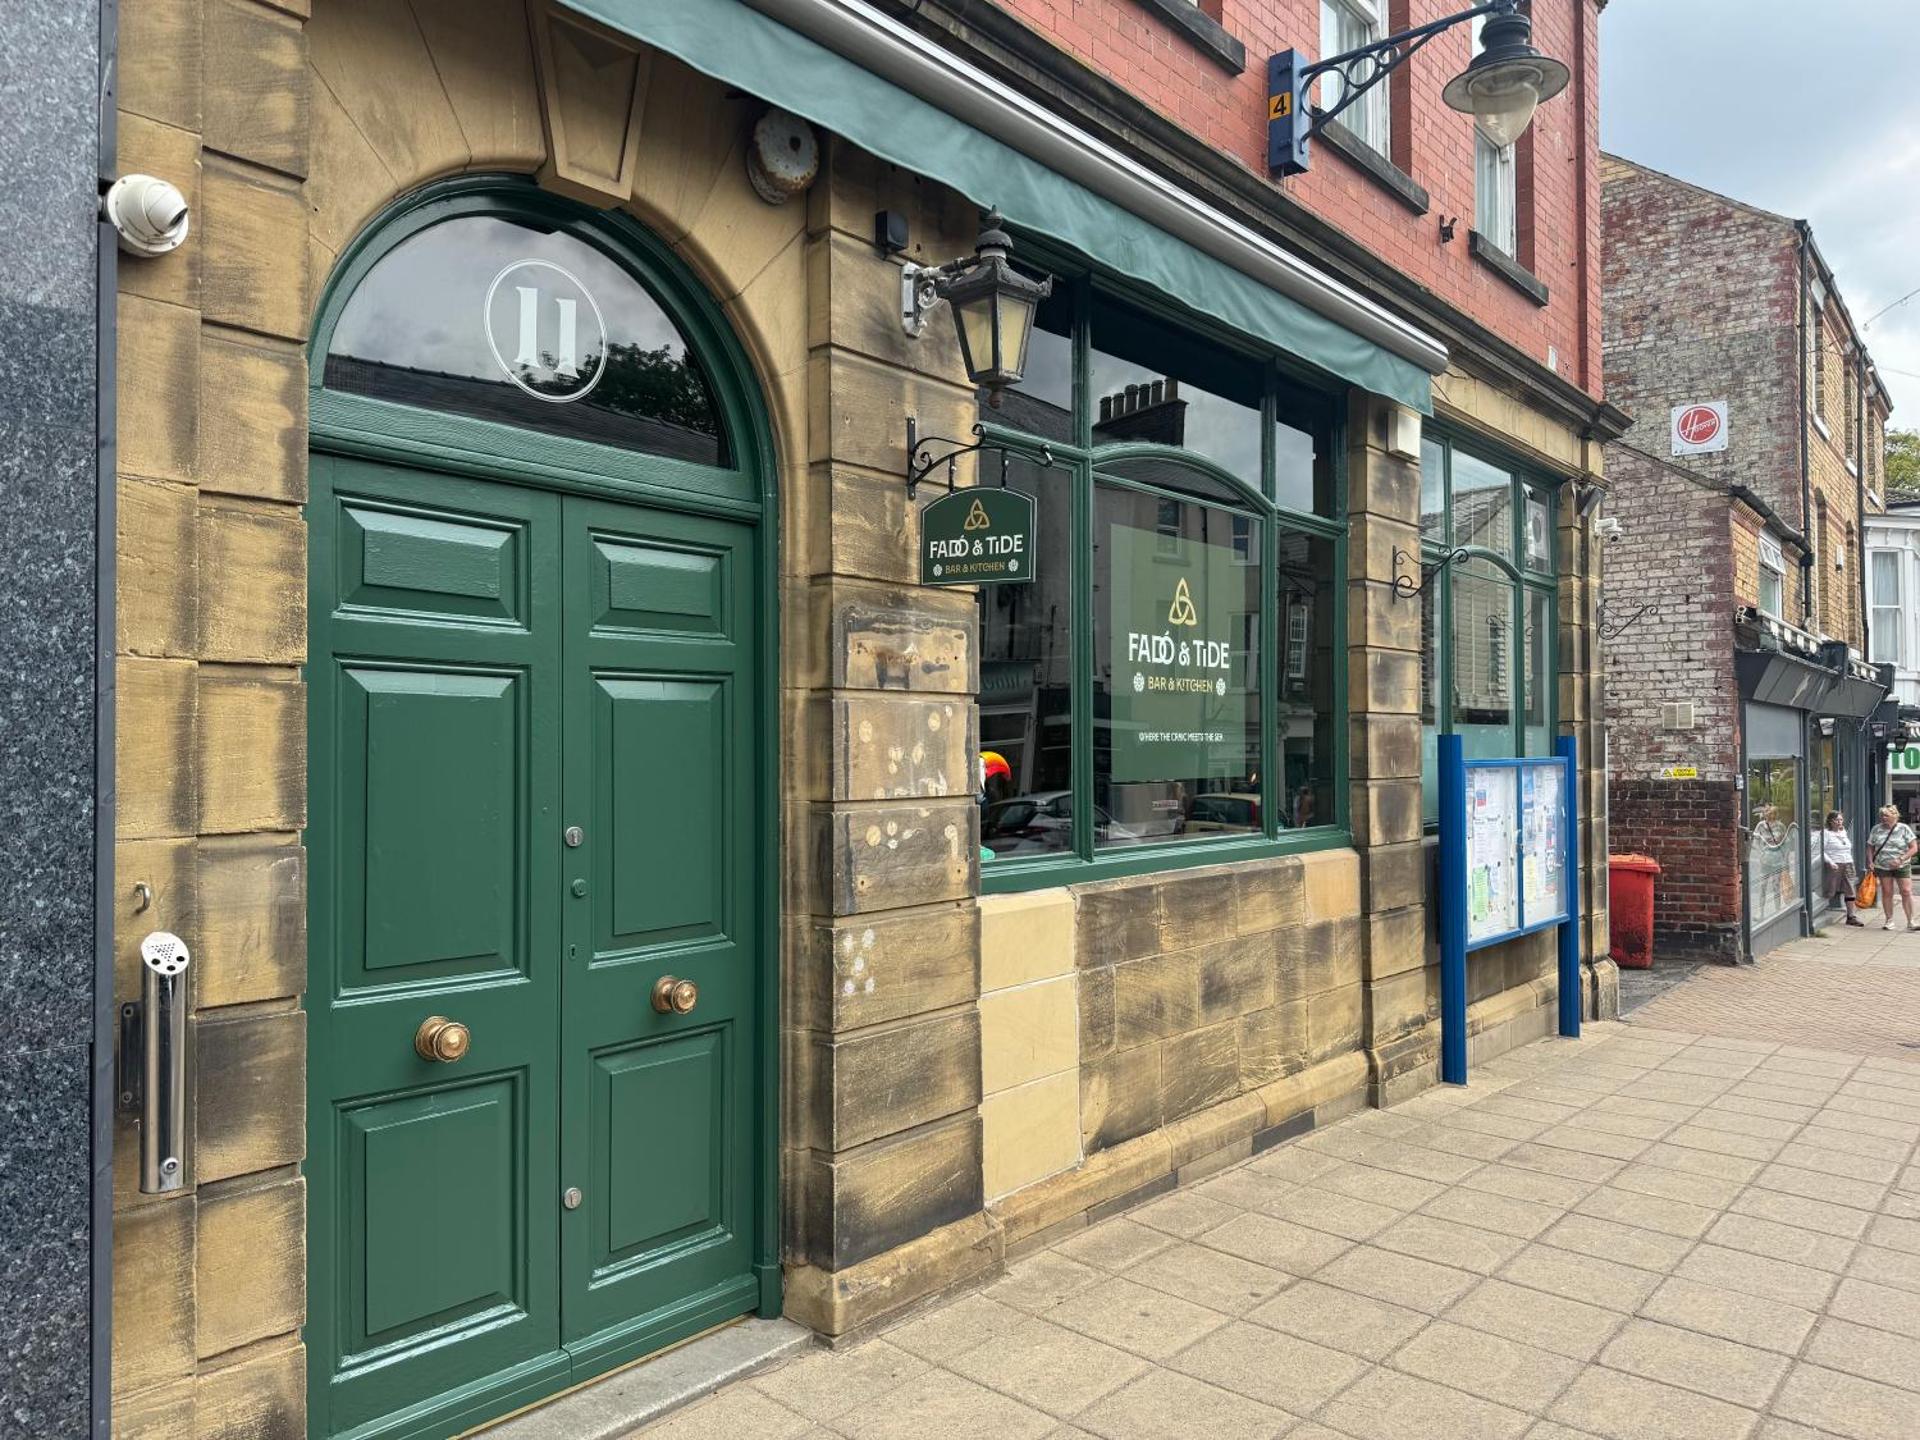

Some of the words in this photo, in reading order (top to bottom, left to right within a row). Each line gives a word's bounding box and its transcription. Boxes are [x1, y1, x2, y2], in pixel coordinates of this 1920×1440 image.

[1273, 95, 1287, 115] 4
[514, 286, 580, 379] 11
[972, 539, 983, 556] &
[945, 564, 961, 574] BAR
[962, 563, 969, 573] &
[969, 561, 1005, 573] KITCHEN
[1178, 641, 1191, 666] &
[1147, 676, 1166, 690] BAR
[1168, 677, 1175, 691] &
[1176, 677, 1213, 692] KITCHEN
[1138, 732, 1159, 742] WHERE
[1160, 732, 1171, 742] THE
